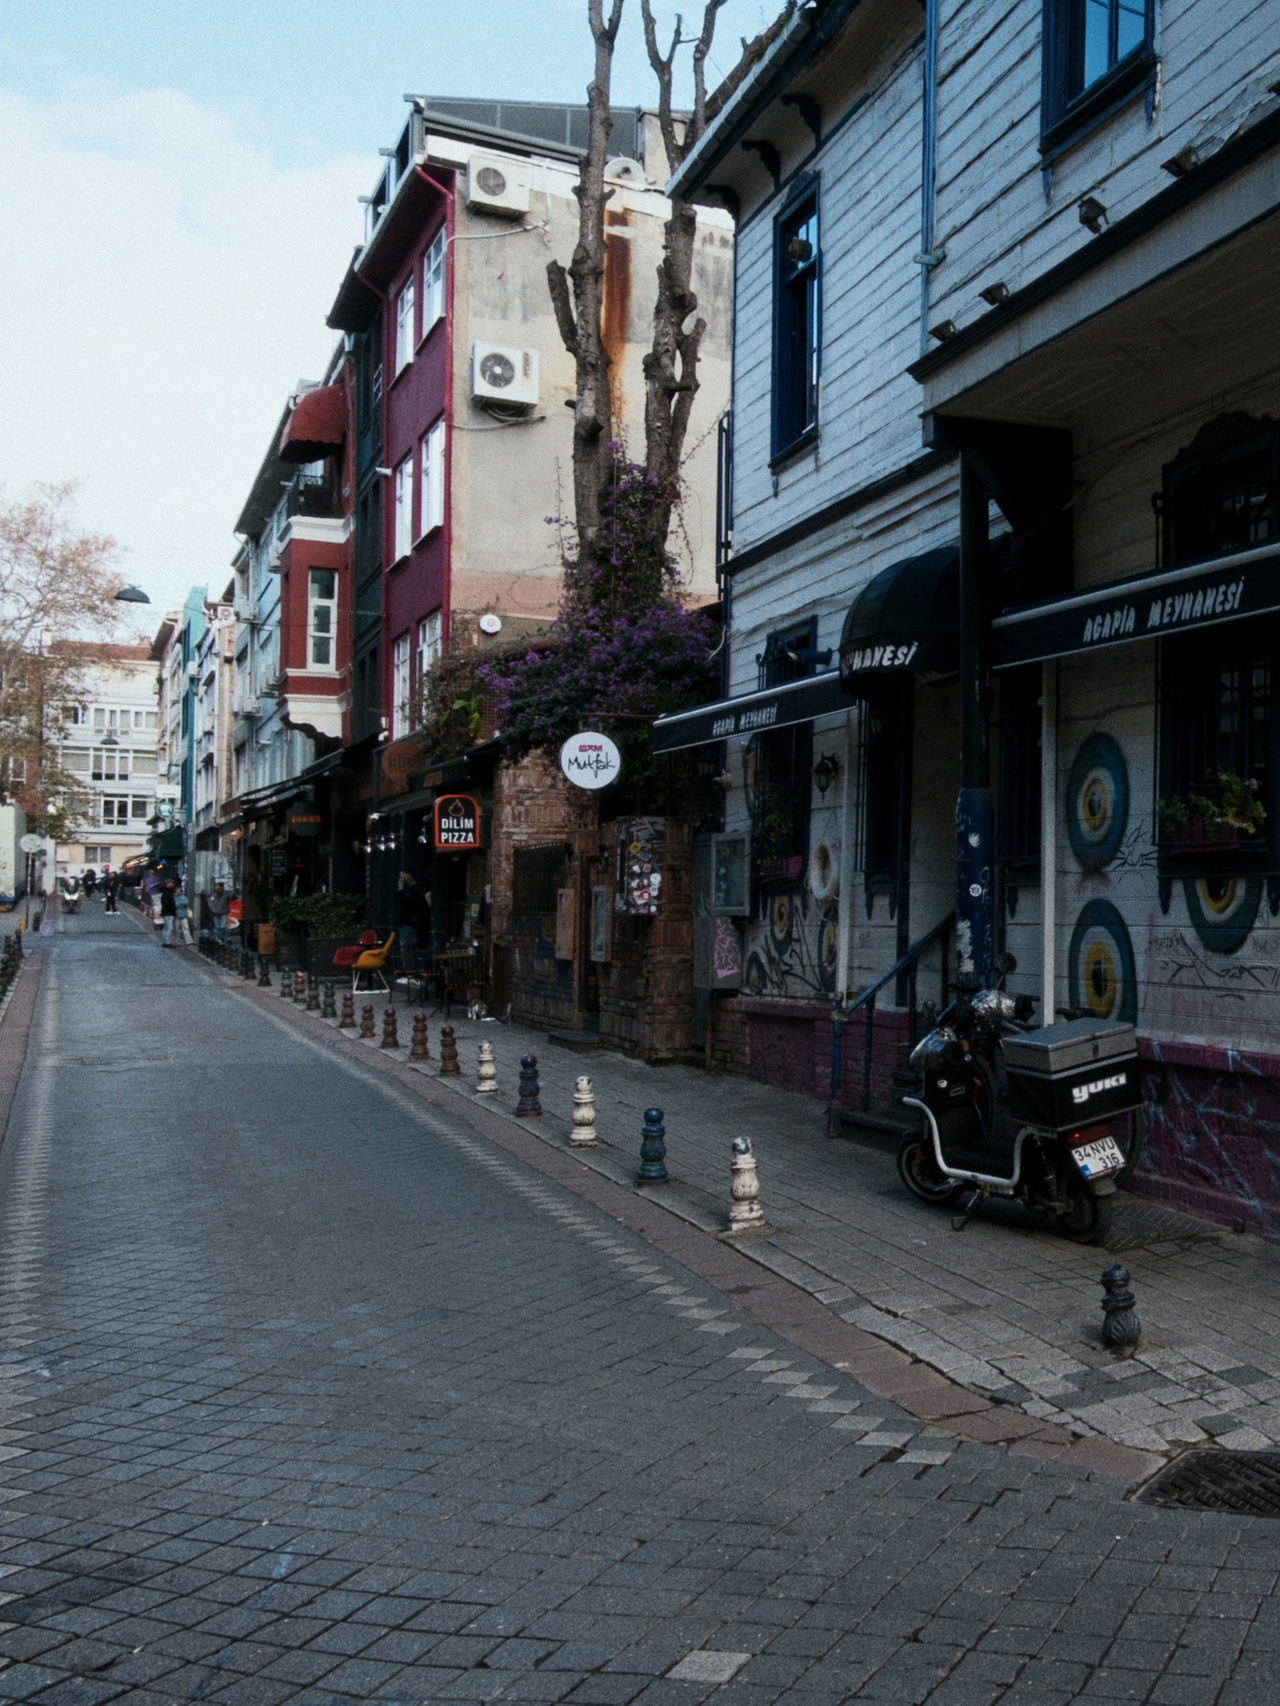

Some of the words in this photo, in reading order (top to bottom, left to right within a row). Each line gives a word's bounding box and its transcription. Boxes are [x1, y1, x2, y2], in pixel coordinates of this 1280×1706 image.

[1082, 604, 1136, 643] AGAPİA
[1147, 575, 1245, 629] MEYHANESİ
[568, 752, 616, 778] Mutfak
[441, 816, 474, 829] DİLİM
[440, 832, 474, 843] PIZZA
[1072, 1073, 1127, 1104] yuki
[1074, 1147, 1091, 1161] 34
[1089, 1138, 1115, 1156] NVU
[1099, 1153, 1120, 1169] 316
